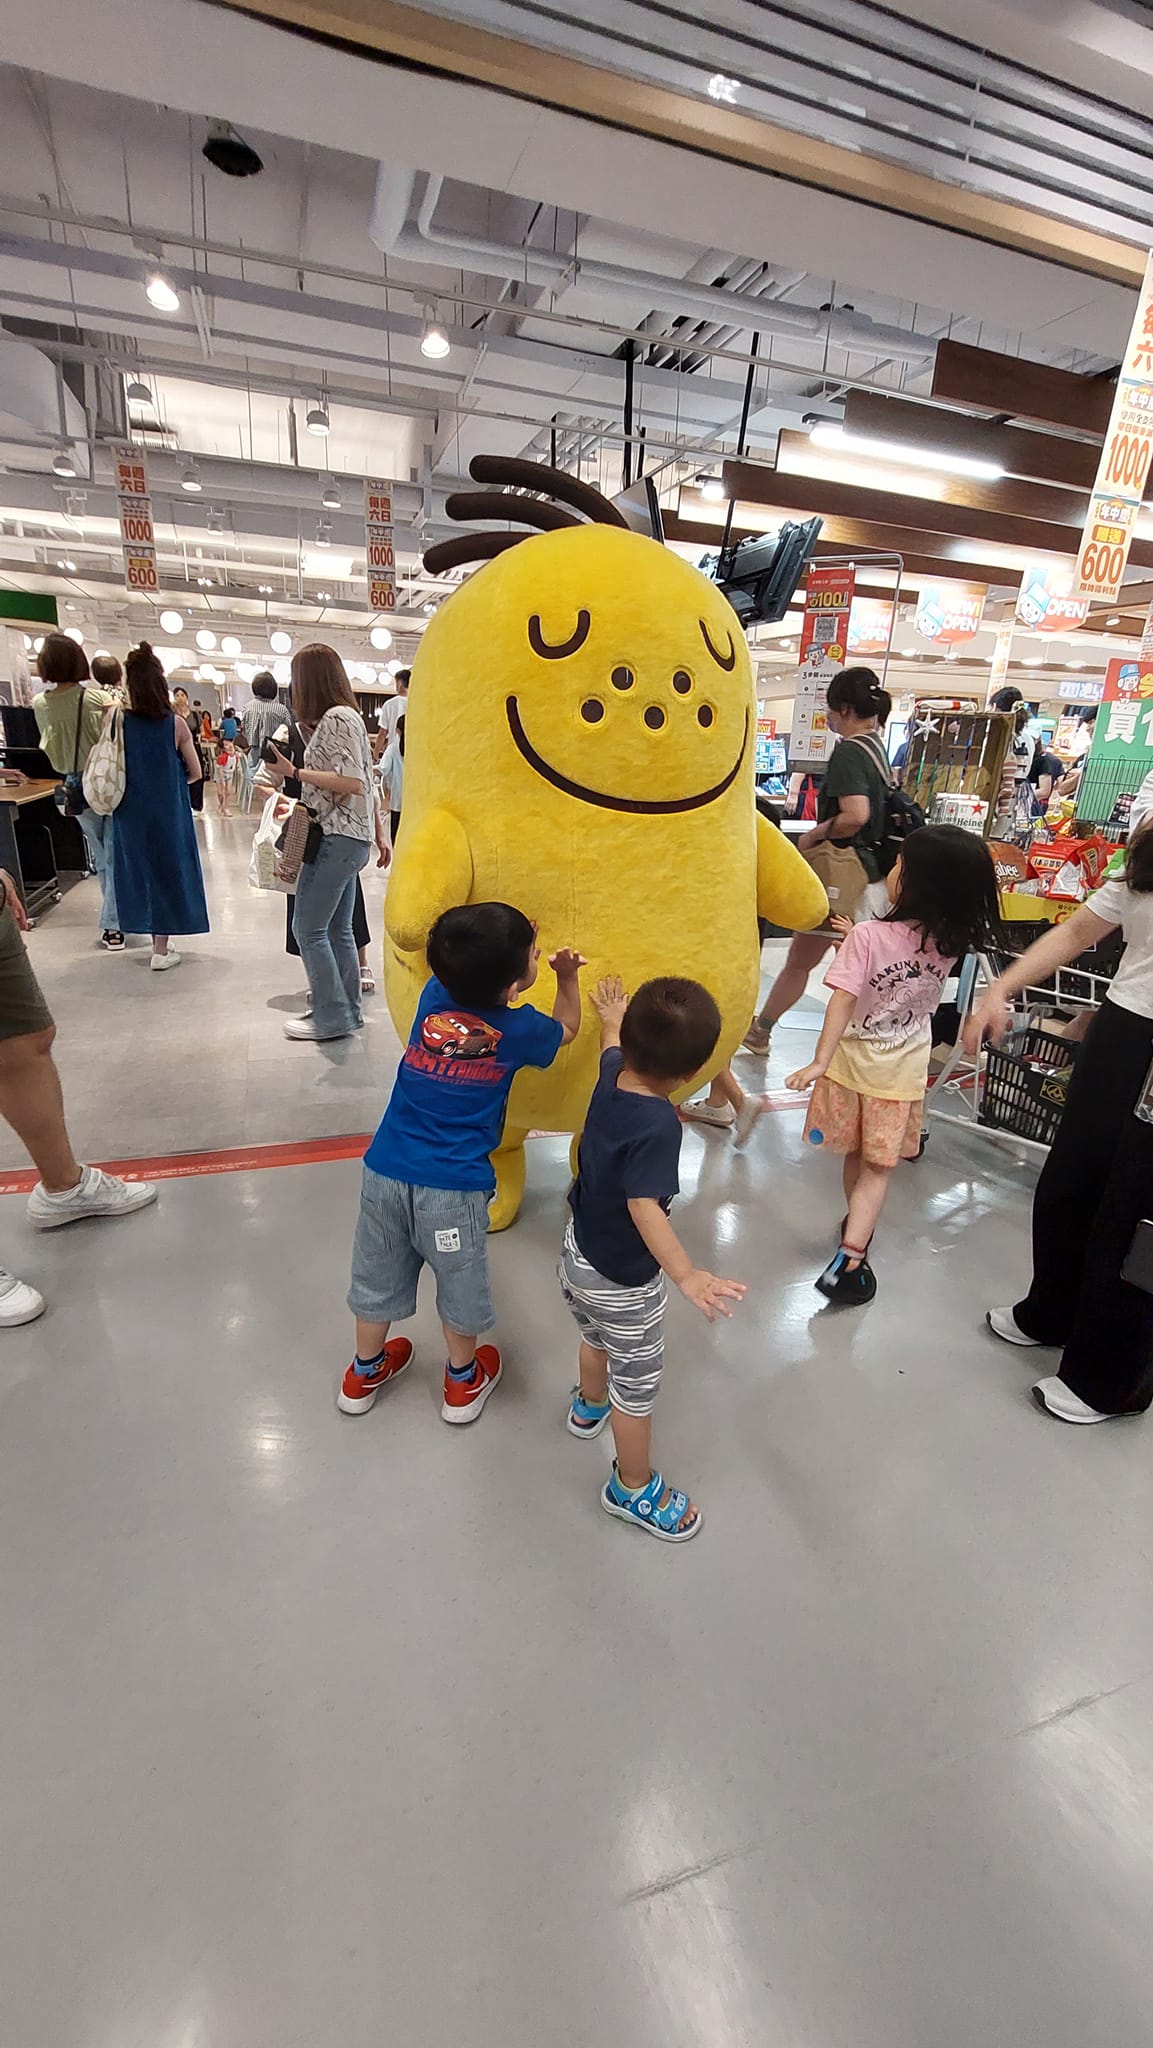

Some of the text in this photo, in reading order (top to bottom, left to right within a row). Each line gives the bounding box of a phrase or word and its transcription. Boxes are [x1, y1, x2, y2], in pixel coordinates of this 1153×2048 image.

[1104, 433, 1150, 490] 1000
[118, 464, 146, 480] 每週
[120, 480, 146, 494] 六日
[368, 496, 391, 510] 每週
[369, 510, 391, 523] 六日
[123, 519, 153, 542] 1000
[369, 545, 394, 567] 1000
[1081, 542, 1124, 585] 600
[128, 567, 157, 586] 600
[370, 590, 395, 607] 600
[1046, 598, 1086, 619] OPEN
[943, 614, 978, 633] OPEN
[957, 817, 984, 830] Heine
[995, 860, 1020, 880] abee
[869, 960, 921, 988] HAKUNA
